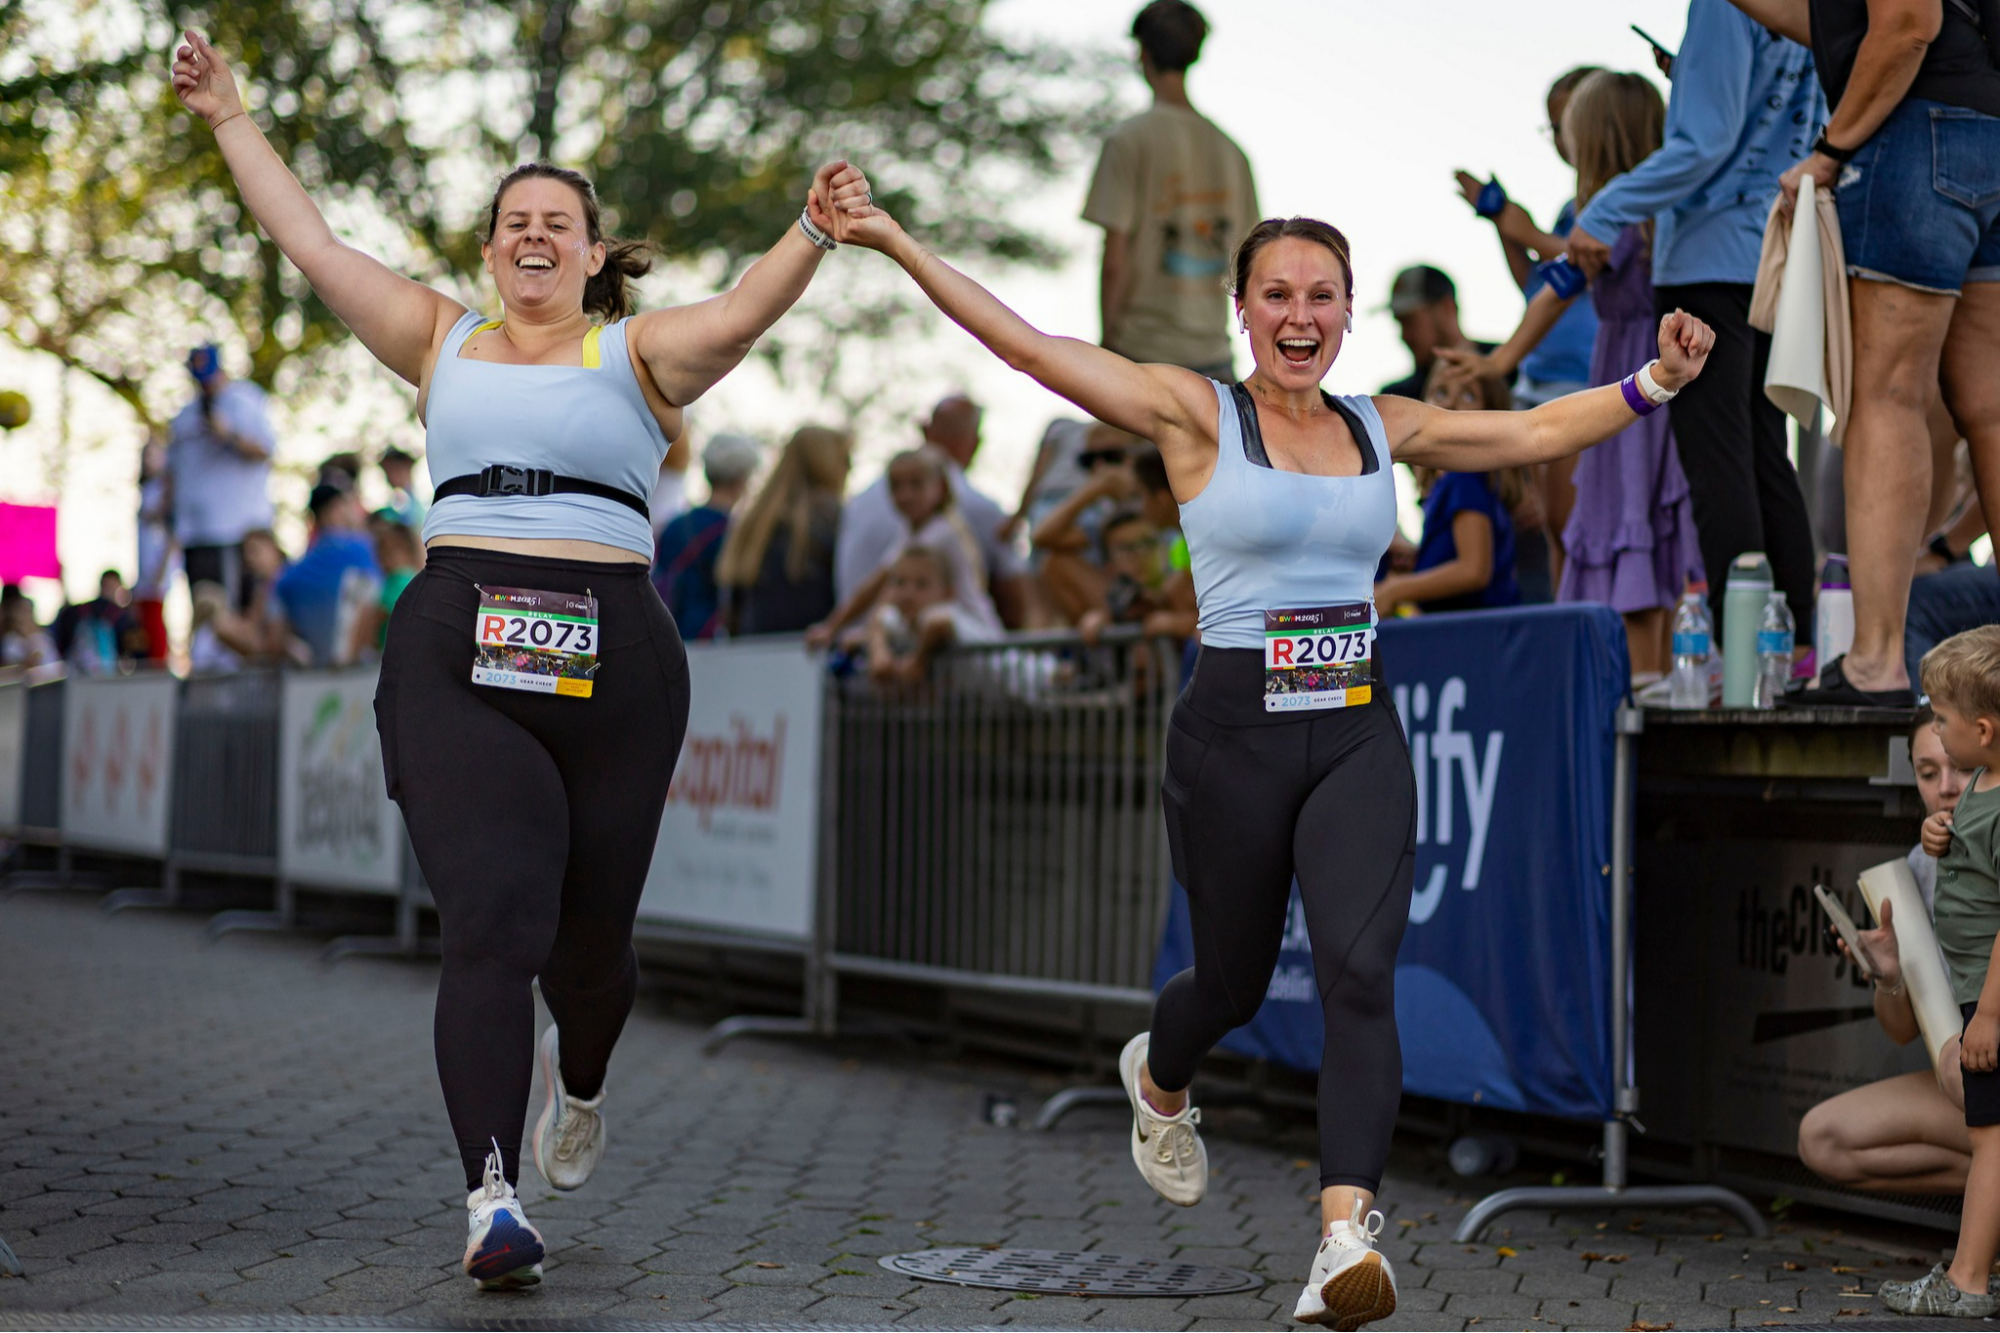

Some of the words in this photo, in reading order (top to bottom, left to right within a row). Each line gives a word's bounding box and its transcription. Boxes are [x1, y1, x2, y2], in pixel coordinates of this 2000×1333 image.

[482, 615, 592, 651] R2073
[1273, 631, 1366, 665] R2073
[485, 672, 517, 685] 2073
[1281, 696, 1311, 707] 2073
[668, 711, 788, 833] apital
